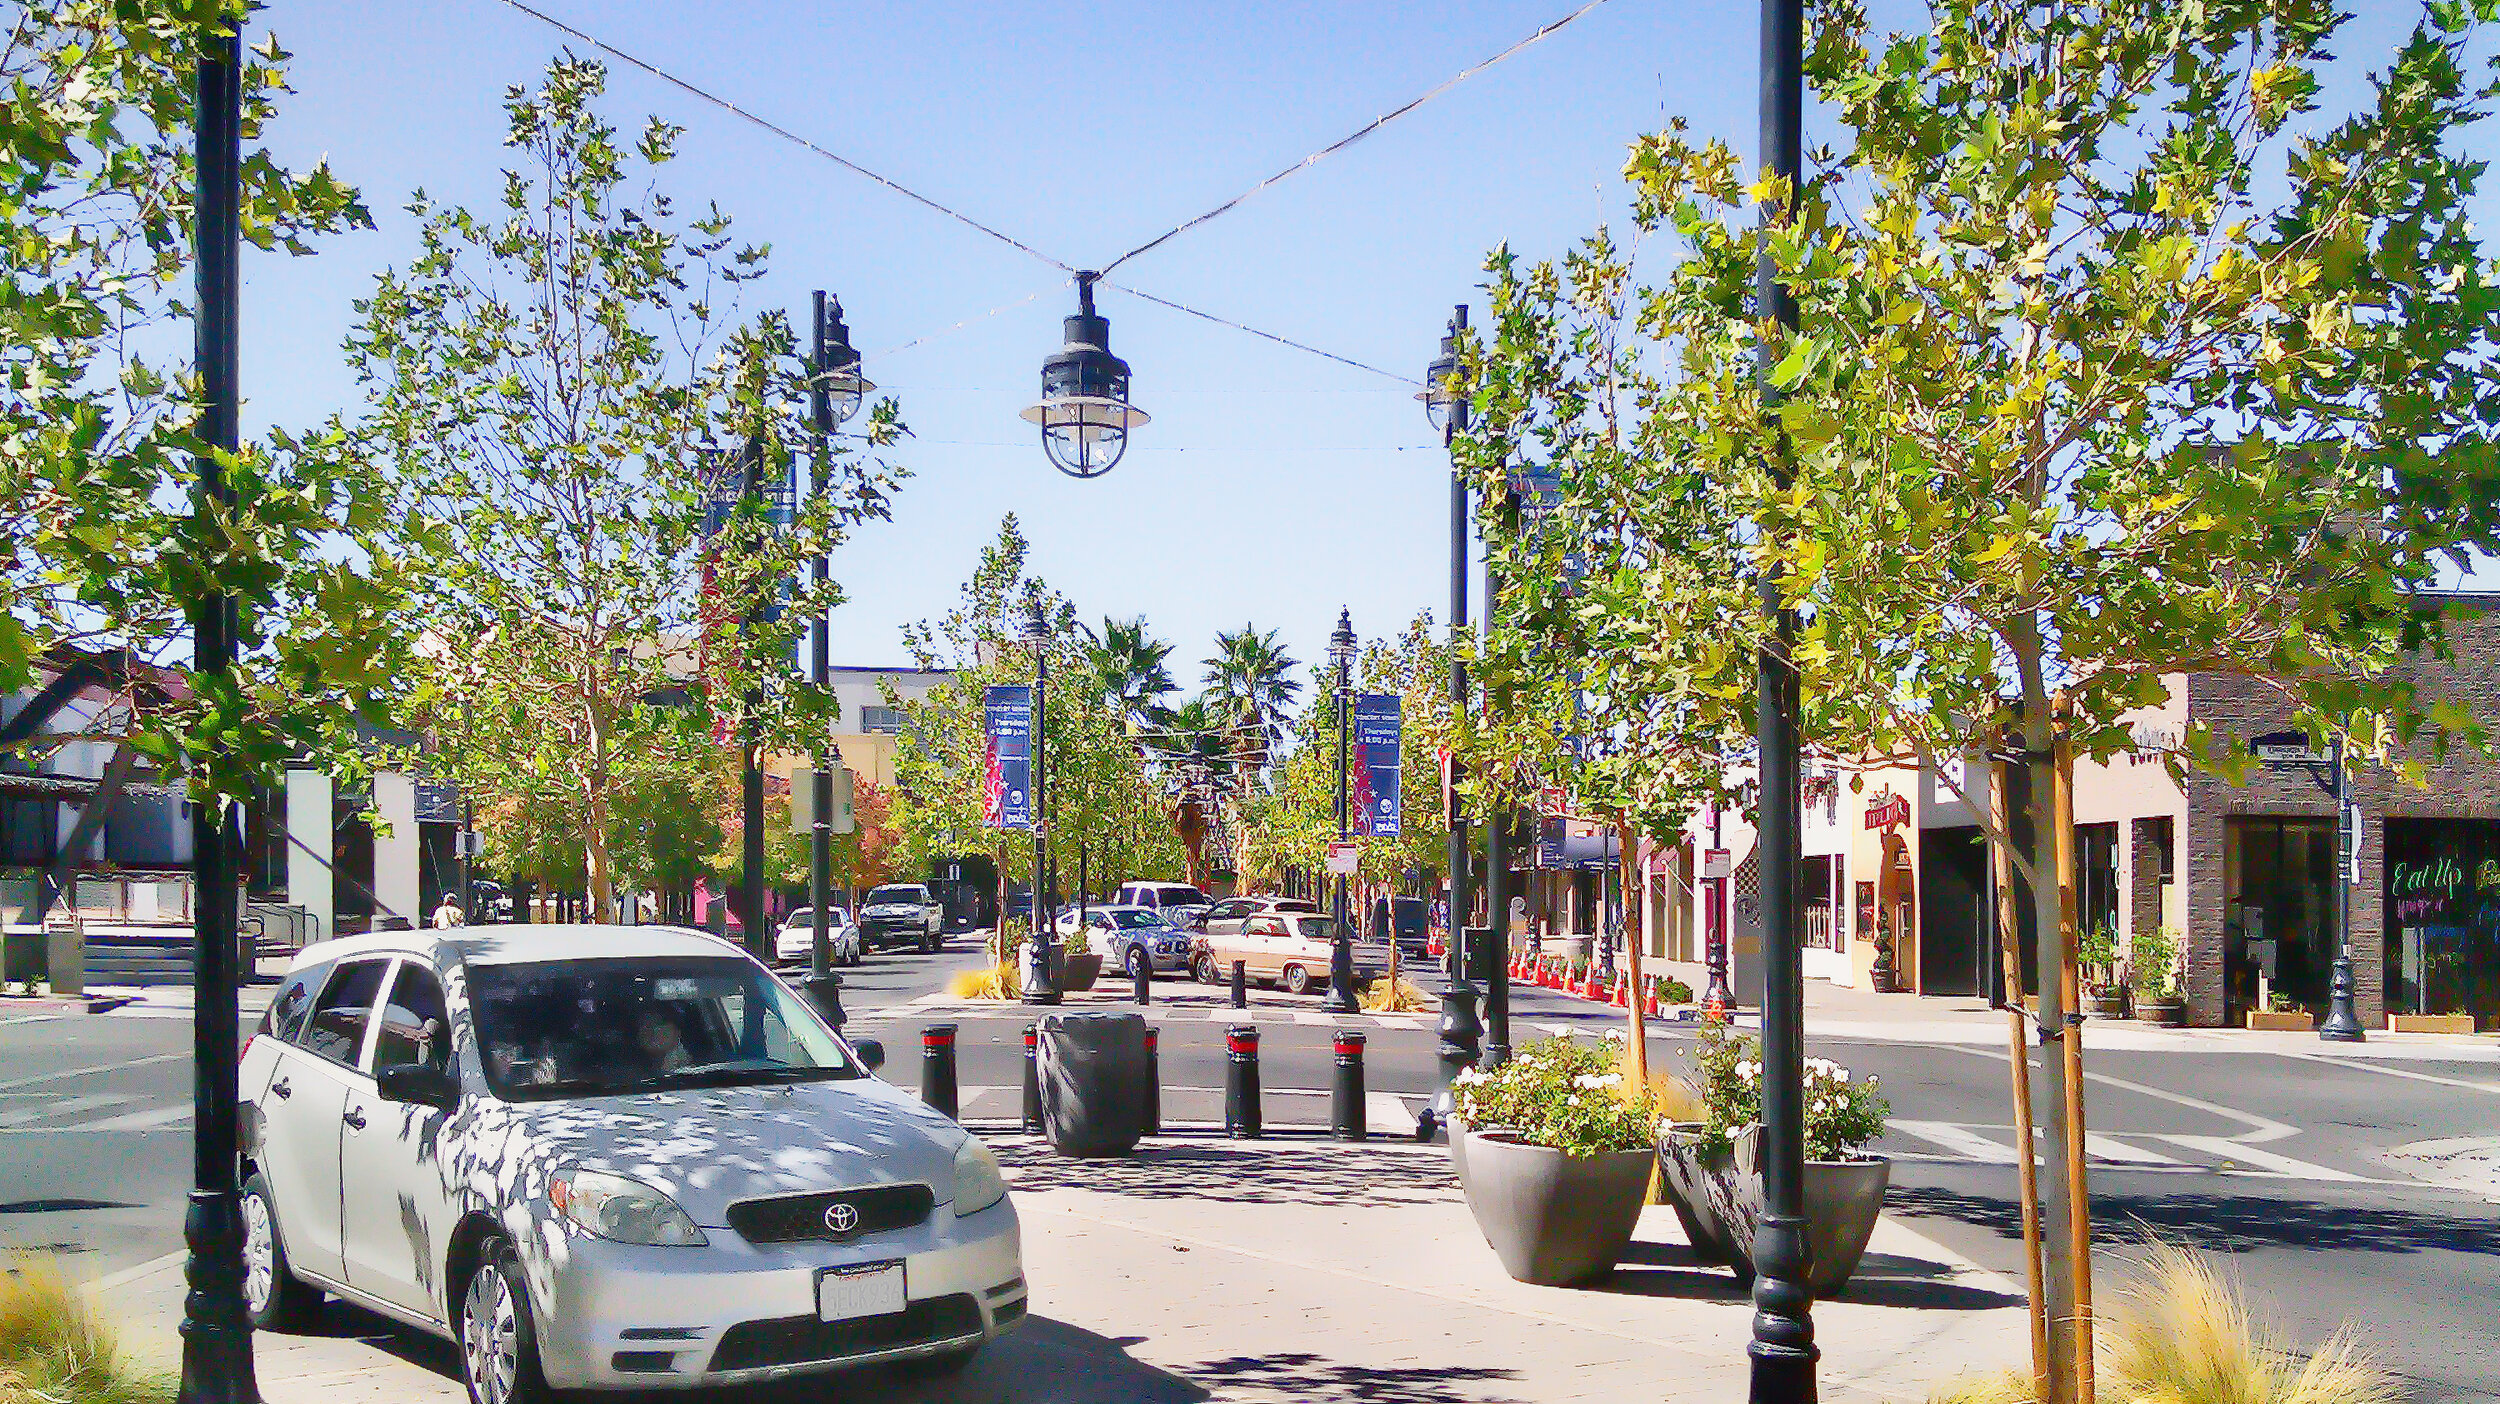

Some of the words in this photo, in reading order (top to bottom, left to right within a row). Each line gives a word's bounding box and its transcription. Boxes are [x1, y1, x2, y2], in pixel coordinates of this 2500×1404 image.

[1364, 727, 1398, 737] Thursdays
[2391, 861, 2430, 897] Eat
[2434, 856, 2463, 900] Up
[827, 1280, 901, 1313] 5ECK936
